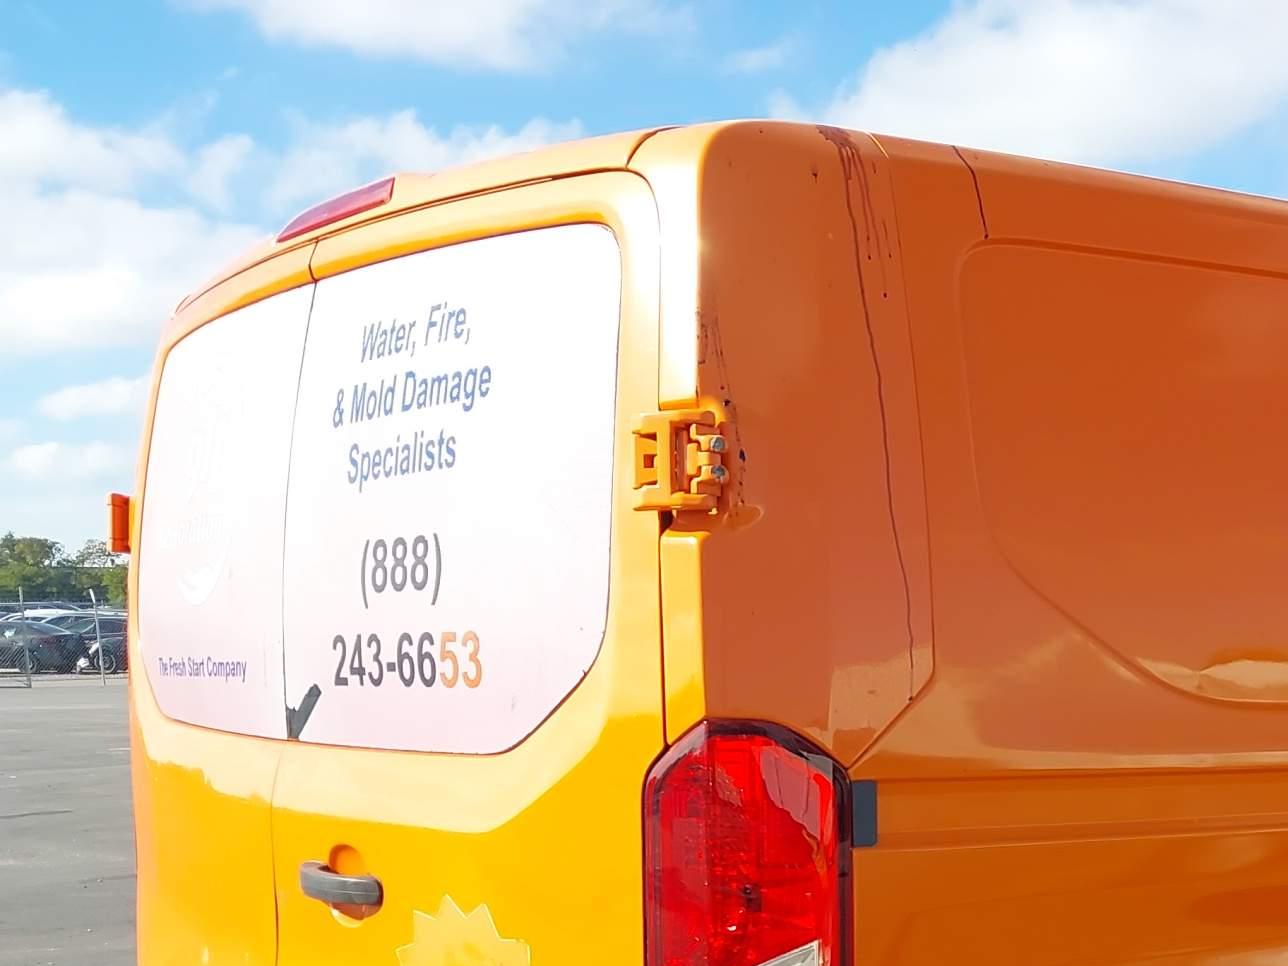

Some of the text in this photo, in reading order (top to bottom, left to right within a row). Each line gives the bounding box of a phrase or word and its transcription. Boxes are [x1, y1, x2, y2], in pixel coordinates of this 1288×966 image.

[360, 301, 471, 364] Water, Fire,
[332, 364, 492, 429] & Mold Damage
[347, 428, 457, 493] Specialists
[360, 532, 442, 610] (888)
[158, 656, 247, 684] The Fresh Start Company
[332, 630, 482, 689] 243-6653
